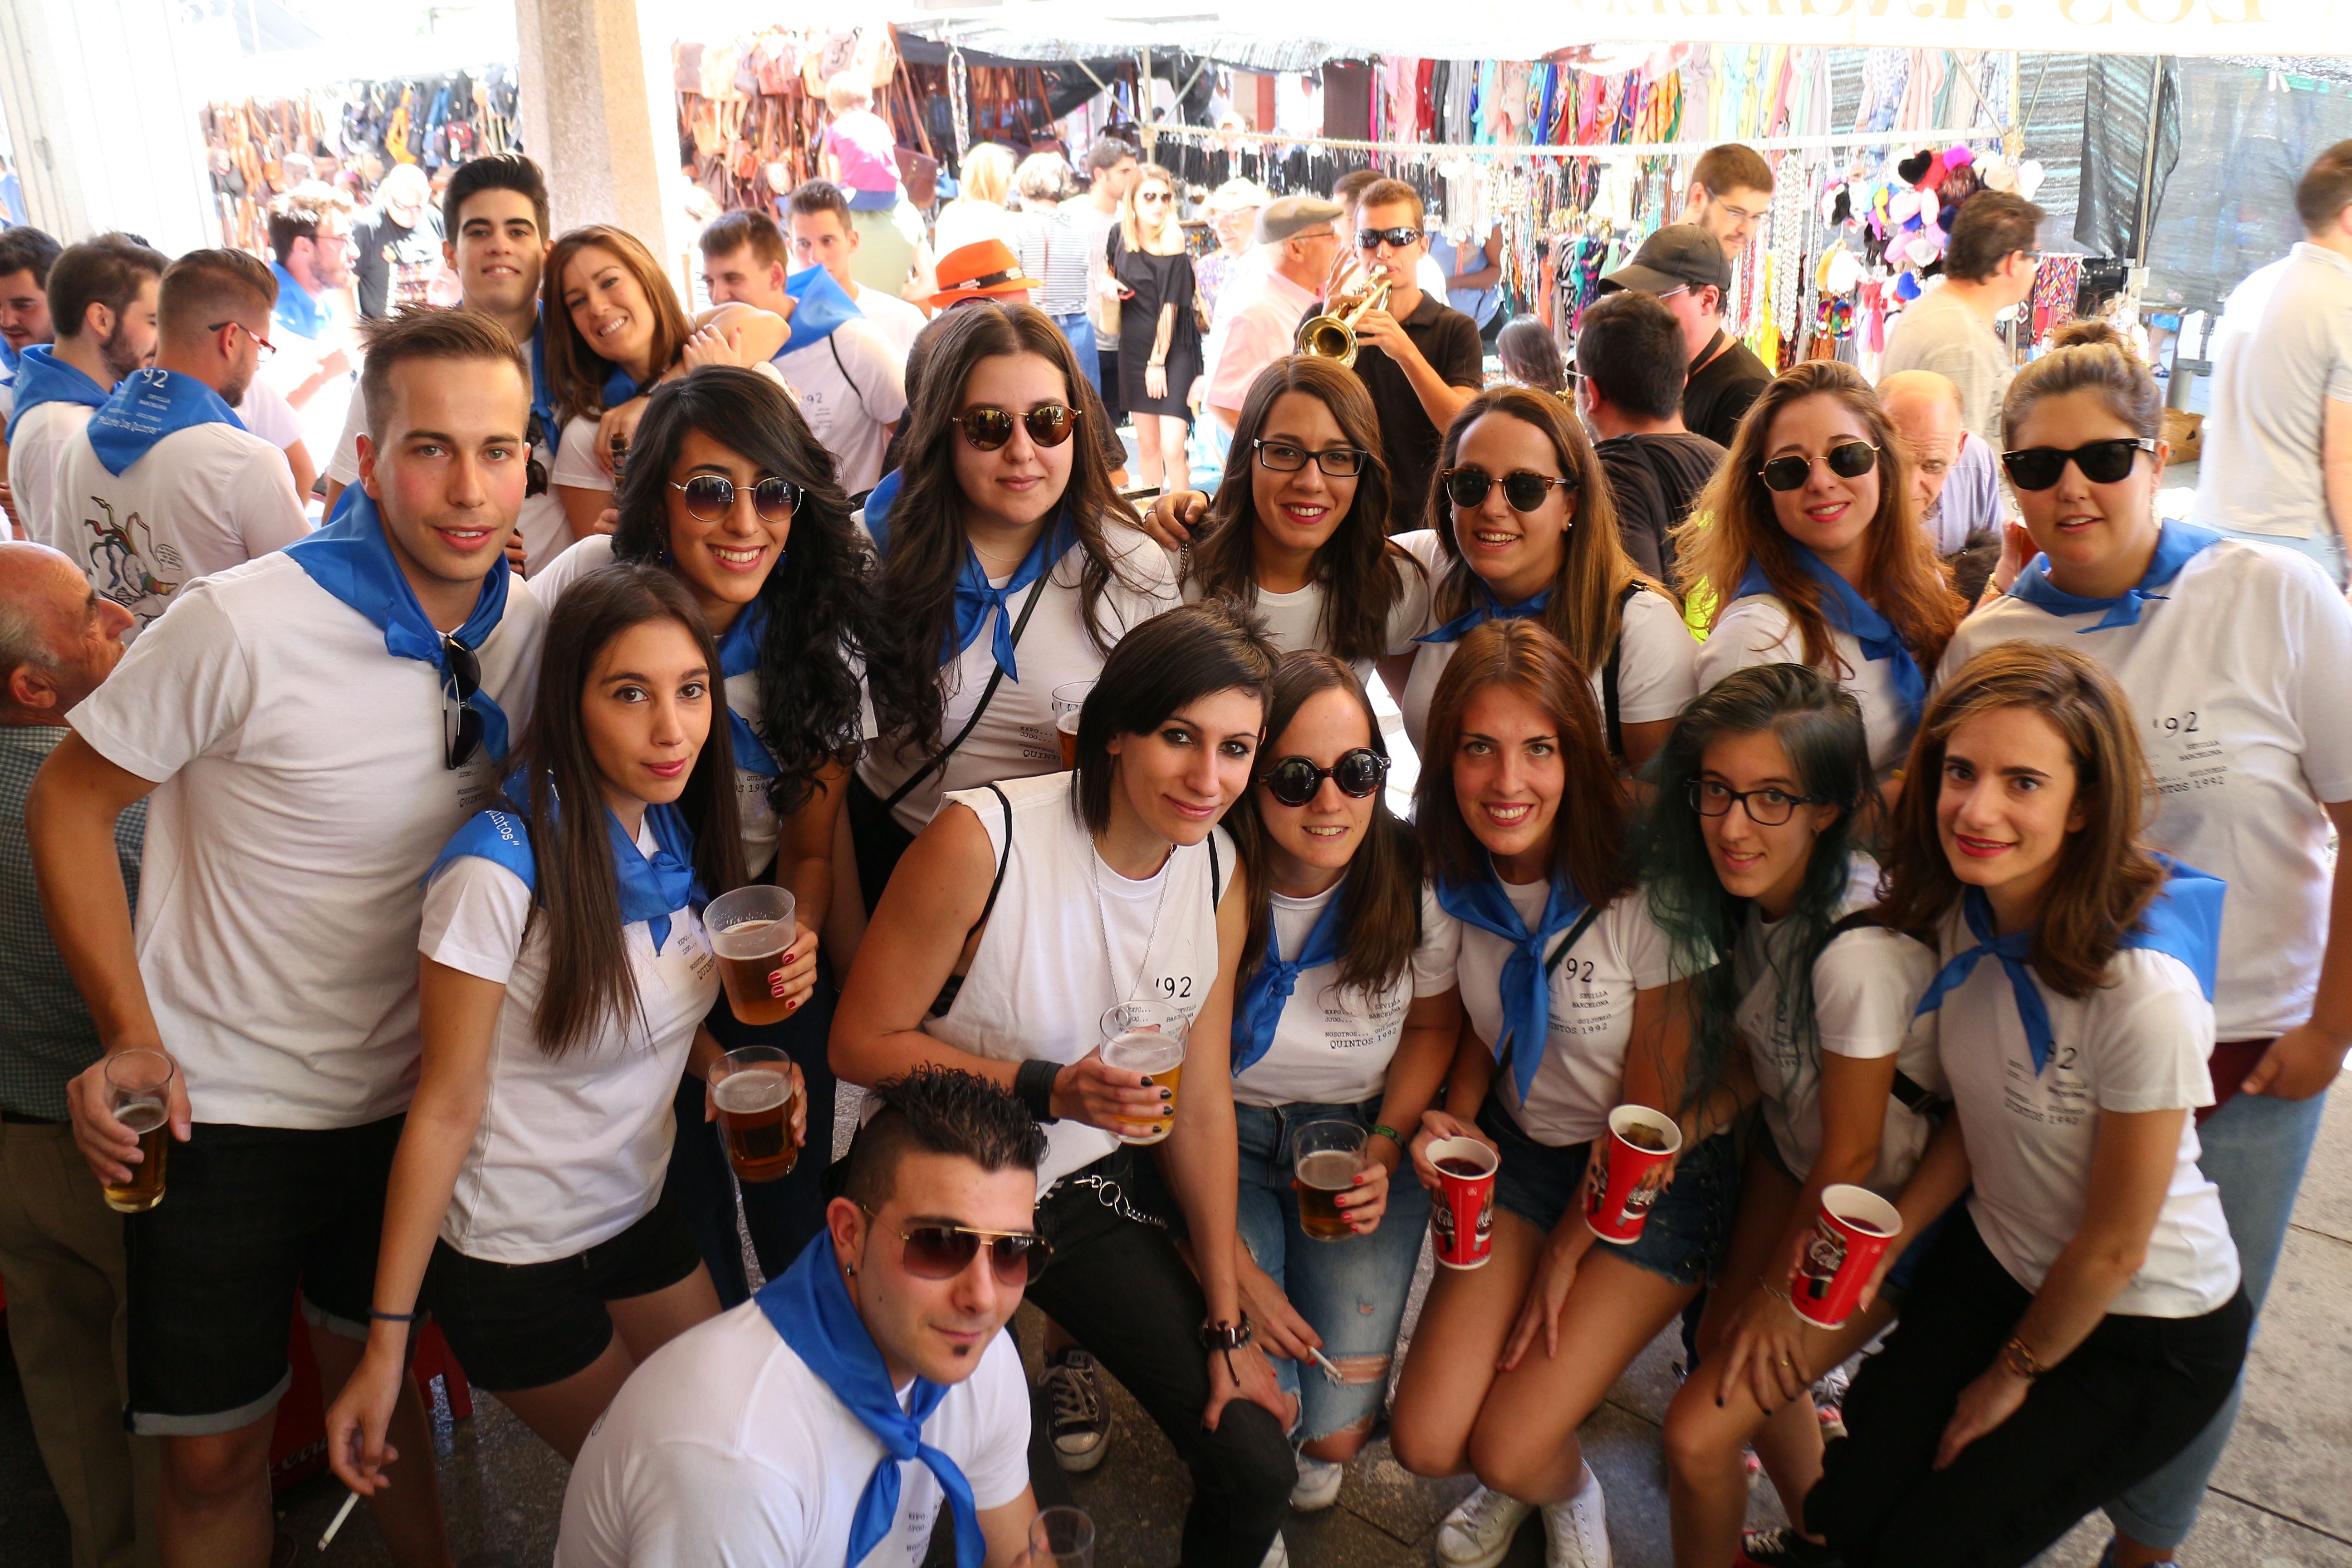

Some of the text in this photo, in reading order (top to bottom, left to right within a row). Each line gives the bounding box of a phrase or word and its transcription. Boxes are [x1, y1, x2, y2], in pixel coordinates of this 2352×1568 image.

[2153, 711, 2199, 738] '92
[1020, 726, 1053, 736] EXPO...
[1020, 732, 1051, 743] JJOO...
[1156, 976, 1192, 1000] '92
[1572, 1000, 1610, 1009] BARCELONA
[1583, 1023, 1608, 1034] 1992
[1330, 1027, 1397, 1049] QUINTOS 1992
